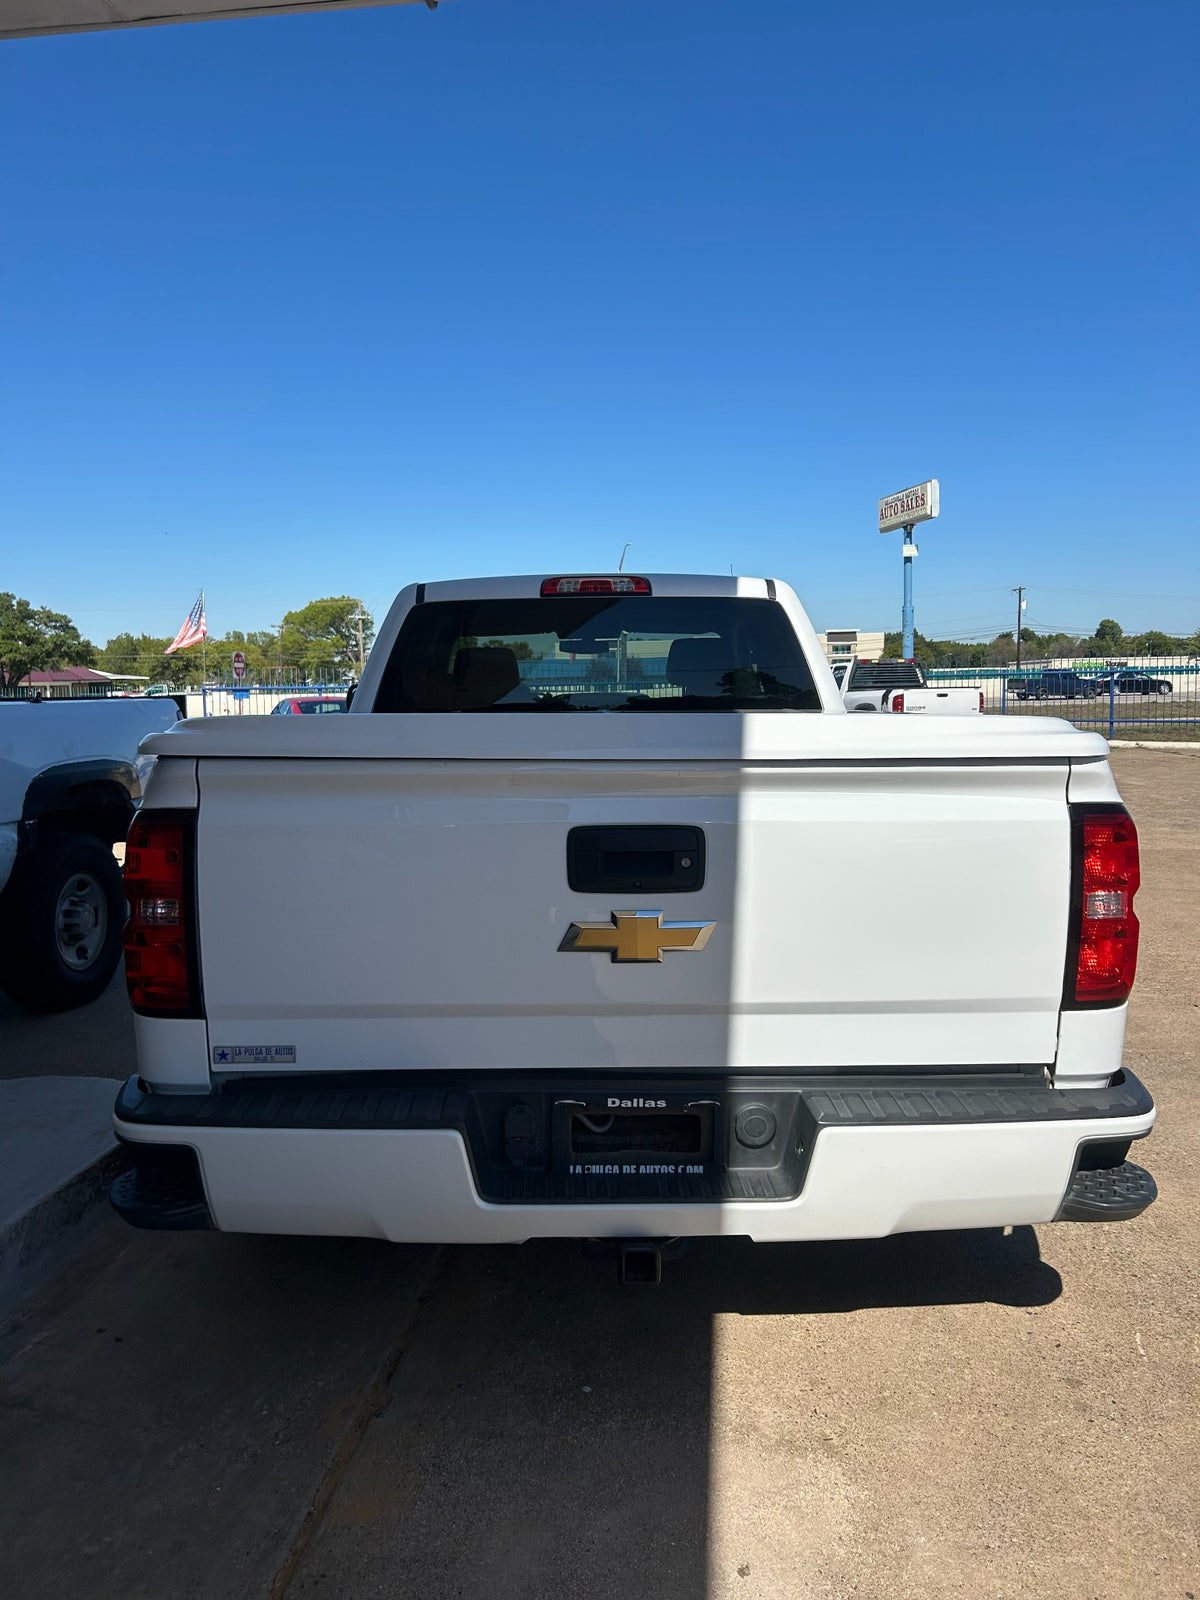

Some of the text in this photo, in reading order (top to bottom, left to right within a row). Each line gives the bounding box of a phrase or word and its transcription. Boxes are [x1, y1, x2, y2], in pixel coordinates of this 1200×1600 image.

[879, 502, 899, 521] AUTO
[900, 492, 926, 514] SALES
[234, 1047, 294, 1057] LA PULGA DE AUTOS
[607, 1098, 667, 1108] Dallas
[622, 1164, 638, 1175] DE
